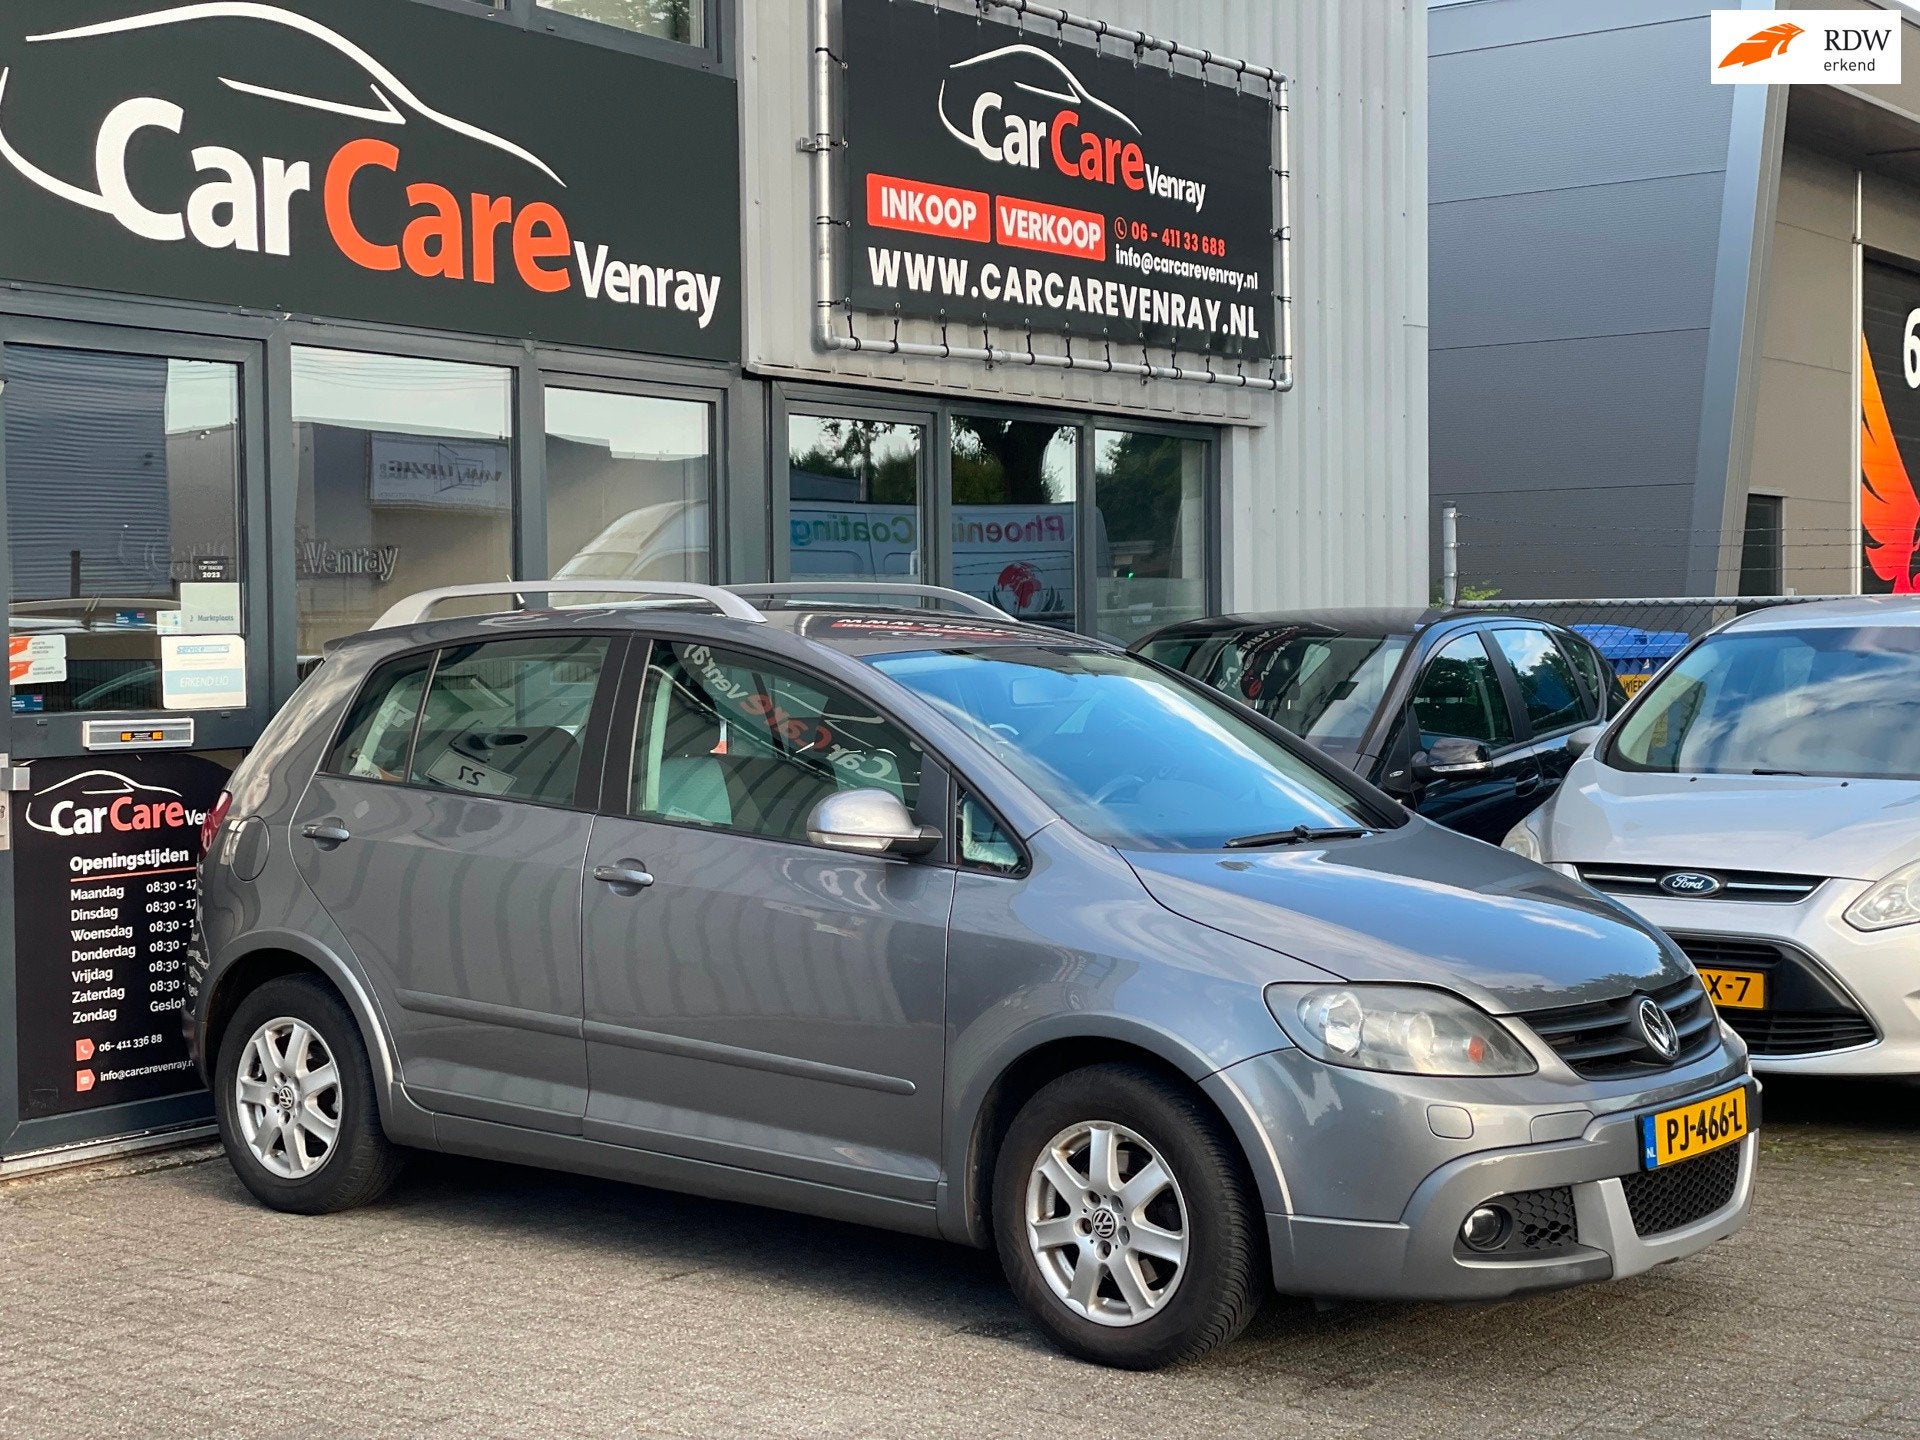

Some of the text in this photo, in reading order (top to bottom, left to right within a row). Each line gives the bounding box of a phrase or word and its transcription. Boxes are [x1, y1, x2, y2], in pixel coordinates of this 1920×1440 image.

[1145, 163, 1206, 212] Venray
[881, 186, 1101, 250] INKOOP VERKOOP
[1131, 220, 1148, 240] 06
[1162, 225, 1181, 249] 411
[1184, 229, 1199, 251] 33
[1202, 232, 1226, 257] 688
[1115, 243, 1258, 292] info@carcarevenray.nl
[573, 241, 721, 328] Venray
[867, 246, 1259, 338] WWW.CARCAREVENRAY.NL
[184, 809, 206, 826] Ve
[70, 848, 189, 874] Openingstijden
[70, 886, 125, 901] Maandag
[146, 880, 177, 893] 08:30
[186, 879, 197, 890] 17
[1672, 873, 1705, 891] Ford
[71, 907, 119, 921] Dinsdag
[145, 901, 176, 913] 08:30
[185, 899, 197, 910] 17
[71, 925, 133, 942] Woensdag
[149, 920, 179, 933] 08:30
[71, 945, 136, 962] Donderdag
[149, 940, 180, 953] 08:30
[71, 968, 113, 984] Vrijdag
[148, 960, 179, 973] 08:30
[71, 987, 125, 1004] Zaterdag
[149, 980, 180, 993] 08:30
[1700, 973, 1751, 1002] X-7
[72, 997, 186, 1024] Zondag Geslot
[116, 1039, 132, 1050] 411
[132, 1036, 149, 1049] 336
[151, 1034, 163, 1044] 88
[100, 1059, 195, 1081] info@carcarevenray.n
[1646, 1098, 1742, 1159] NL PJ-466-L
